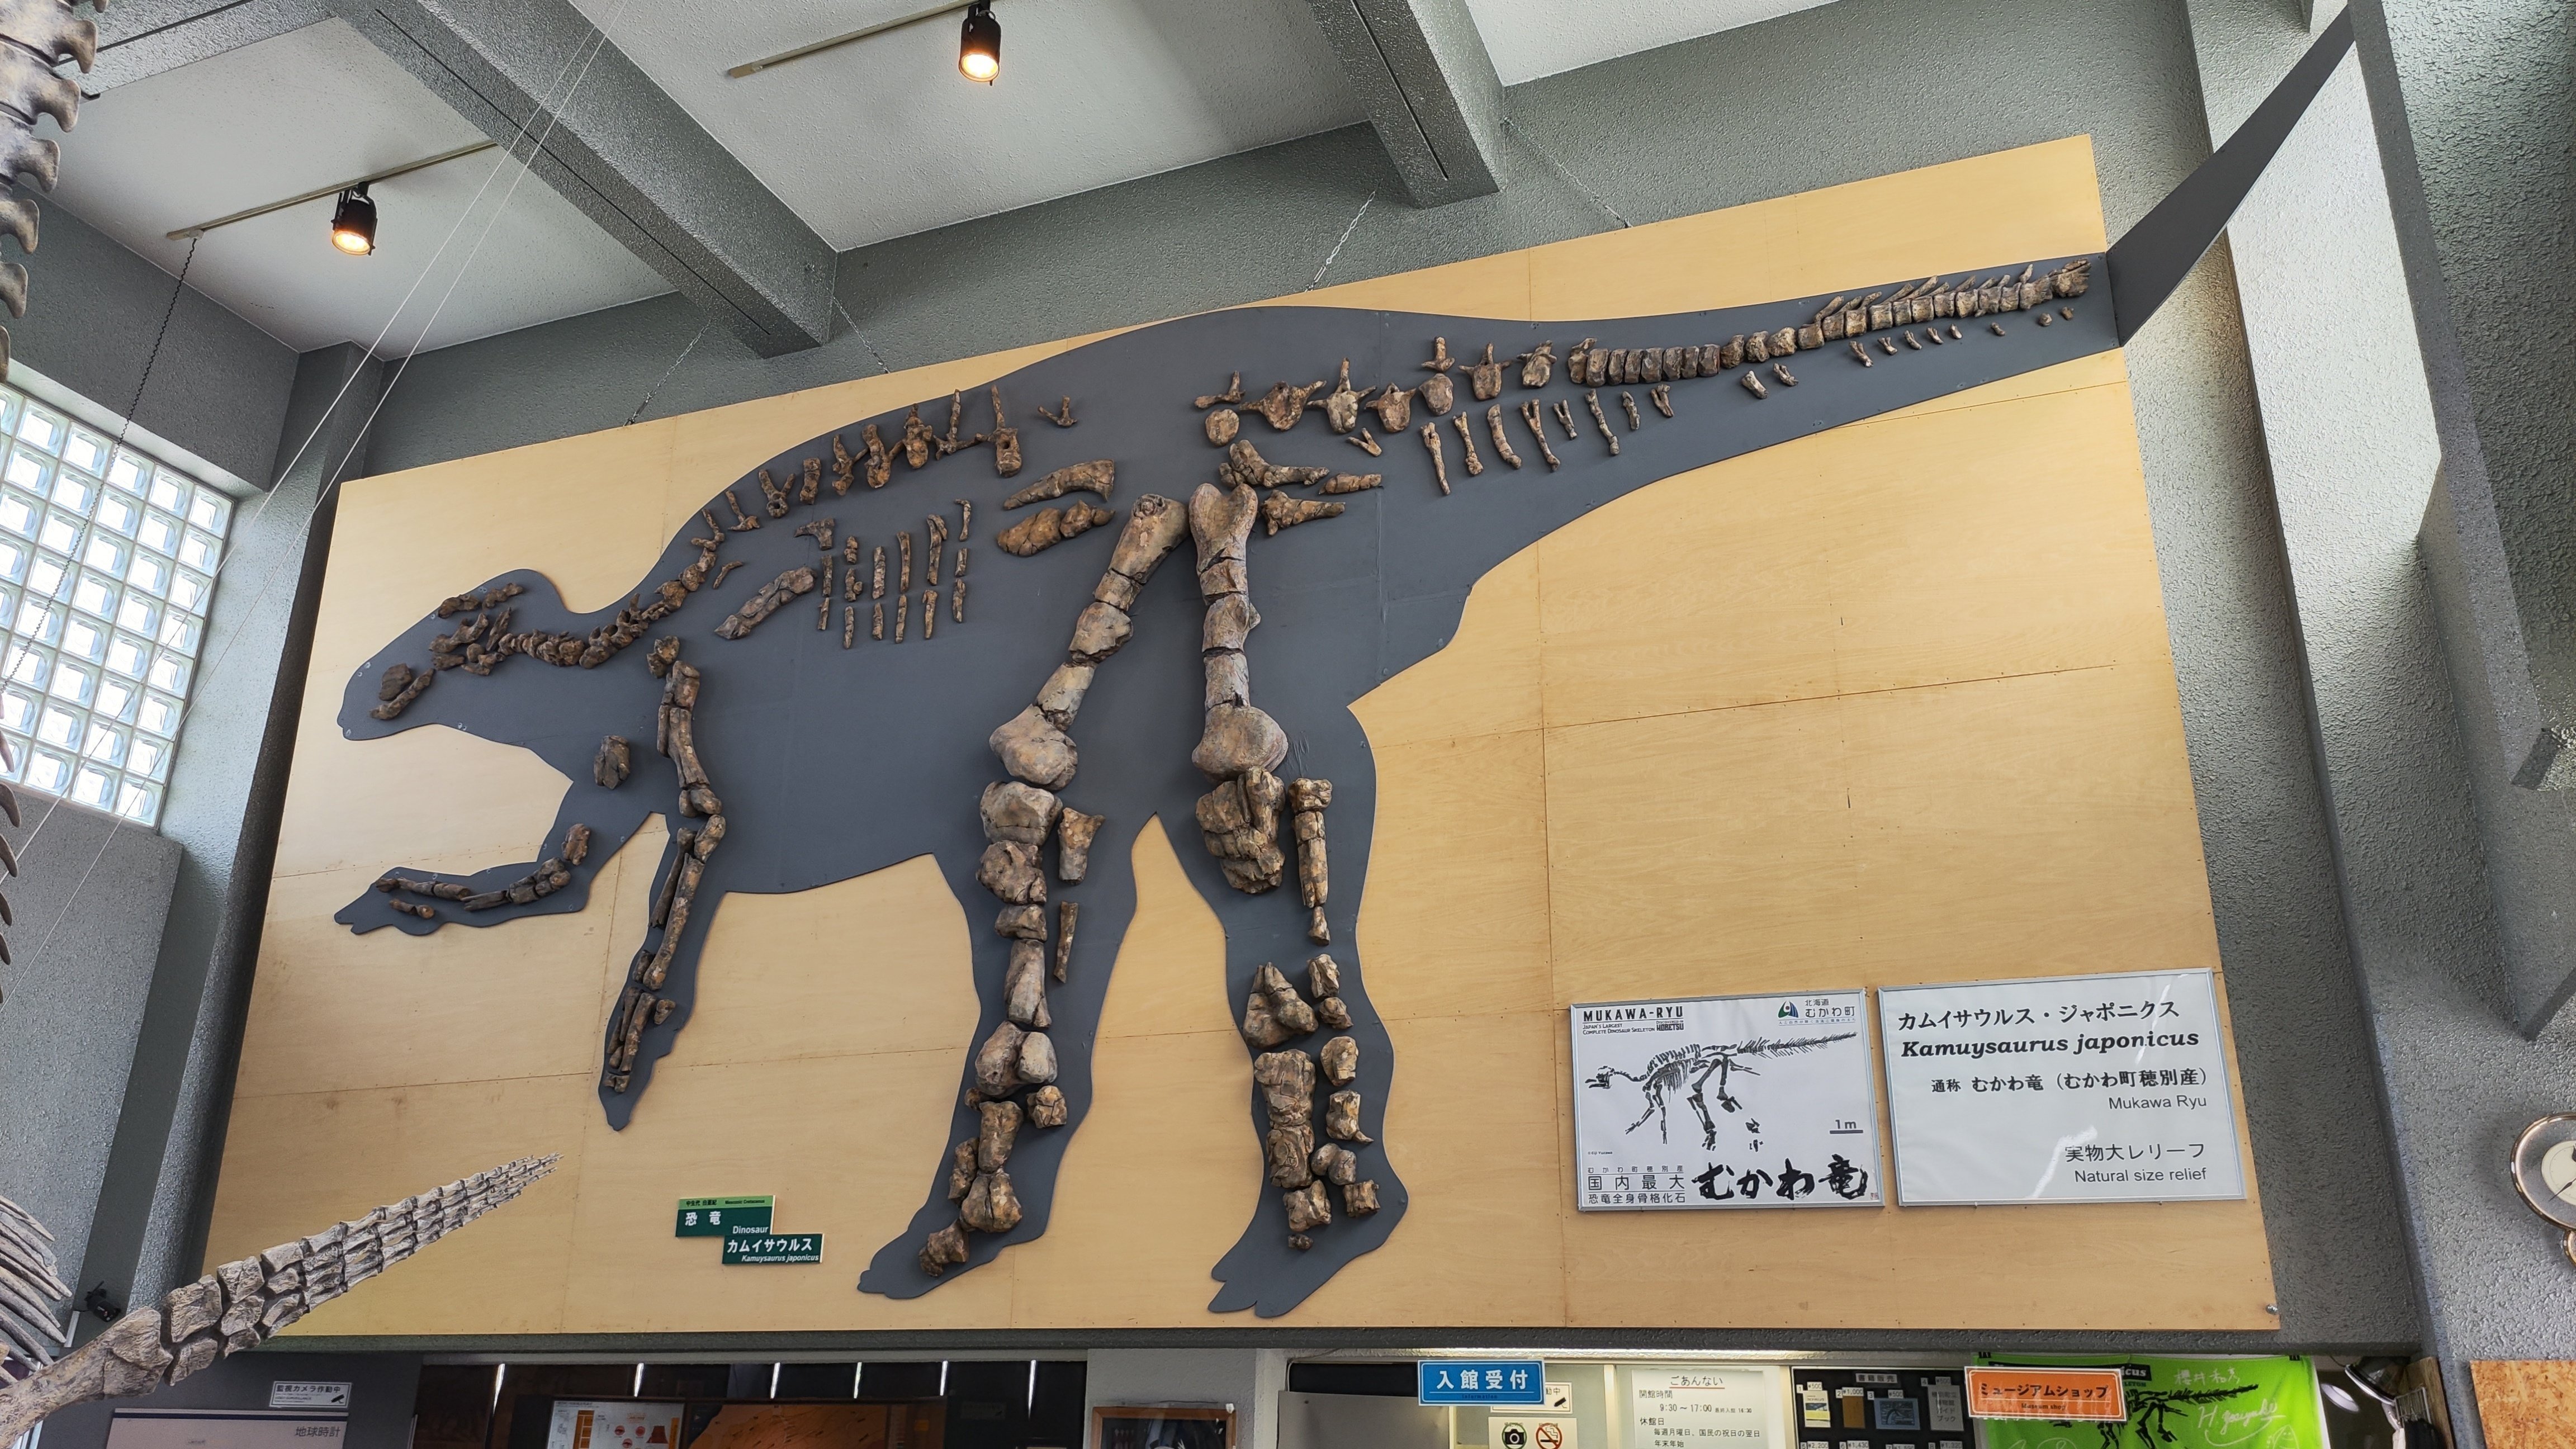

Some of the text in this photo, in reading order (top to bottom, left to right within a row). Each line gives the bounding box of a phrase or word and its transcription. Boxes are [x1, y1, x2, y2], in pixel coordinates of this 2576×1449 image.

[1584, 1006, 1683, 1021] MUKAWA-RYU
[1805, 1006, 1855, 1017] むかわ町
[1898, 1001, 2179, 1031] カムイサウルス・ジャポニクス
[1901, 1031, 2199, 1059] Kamuysaurus japonicus
[1931, 1079, 1961, 1093] 通称
[2109, 1095, 2206, 1109] Mukawa Ryu
[2064, 1143, 2204, 1163] 実物大レリーフ
[1588, 1165, 1684, 1173] むかわ町穂別産
[2075, 1167, 2206, 1182] Natural size relief
[1588, 1175, 1685, 1190] 国内最大
[1691, 1154, 1868, 1200] むかわ竜
[1588, 1193, 1685, 1204] 恐竜全身骨格化石
[685, 1211, 721, 1226] 恐竜
[727, 1238, 812, 1253] カムイサウルス
[741, 1254, 785, 1263] Kamuysaurus
[1436, 1369, 1528, 1390] 入館受付
[1670, 1376, 1723, 1386] ごあんない
[1639, 1390, 1673, 1399] 開館時間
[1981, 1383, 2109, 1398] ミュージアムショップ
[295, 1426, 340, 1437] 地球時計
[1655, 1439, 1684, 1448] 年末年始
